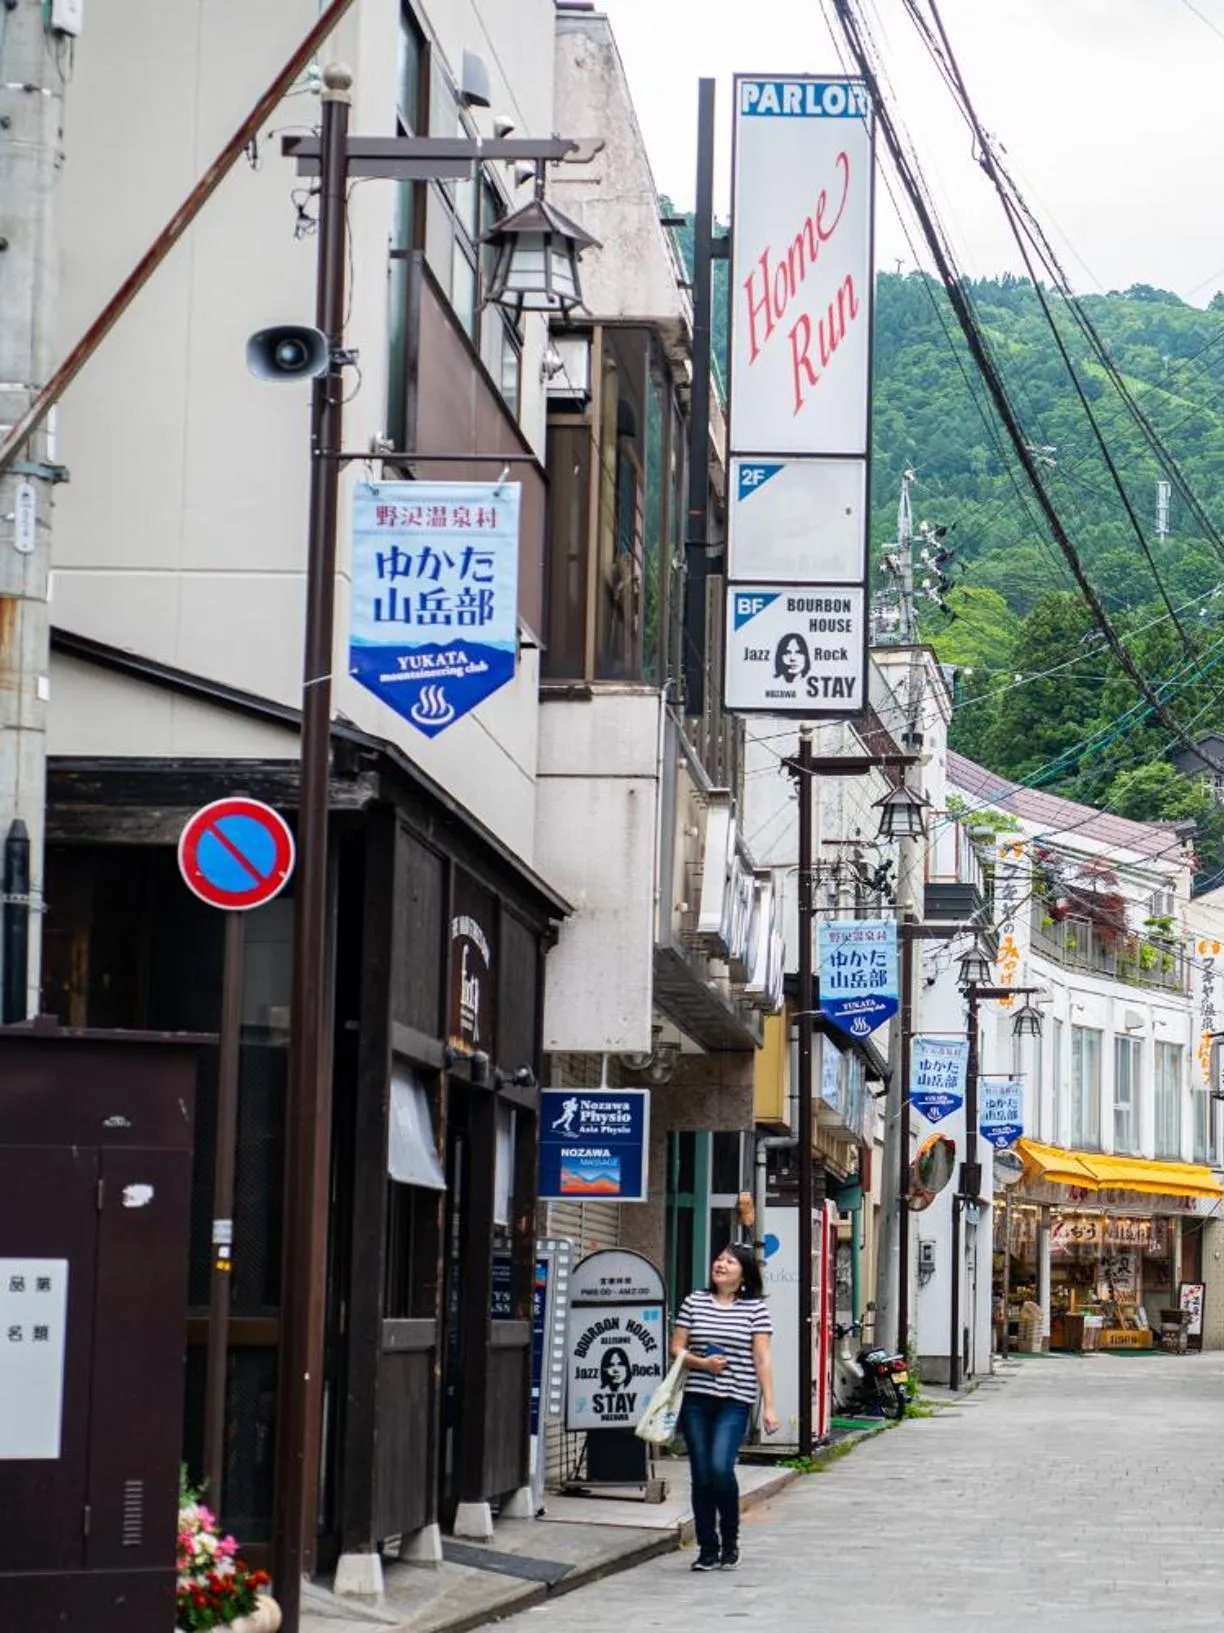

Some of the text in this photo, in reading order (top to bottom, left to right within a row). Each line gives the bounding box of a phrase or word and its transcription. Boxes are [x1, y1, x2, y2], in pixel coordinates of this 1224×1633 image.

[741, 83, 870, 116] PARLOR
[743, 151, 850, 366] Home
[788, 273, 860, 418] Run
[741, 470, 765, 486] 2F
[375, 504, 497, 529] 野沢温泉村
[375, 545, 496, 583] ゆかた
[373, 587, 495, 627] 山岳部
[737, 598, 851, 615] BF BOURBON
[809, 619, 852, 633] HOUSE
[397, 651, 469, 671] YUKATA
[744, 647, 848, 661] Jazz Rock
[806, 676, 857, 699] STAY
[830, 950, 887, 968] ゆかた
[831, 968, 888, 989] 山岳部
[580, 1100, 631, 1111] Nozawa
[580, 1110, 632, 1126] Physio
[561, 1148, 611, 1158] NOZAWA
[574, 1316, 658, 1359] BOURBON HOUSE
[575, 1366, 599, 1379] Jazz
[592, 1393, 637, 1414] STAY
